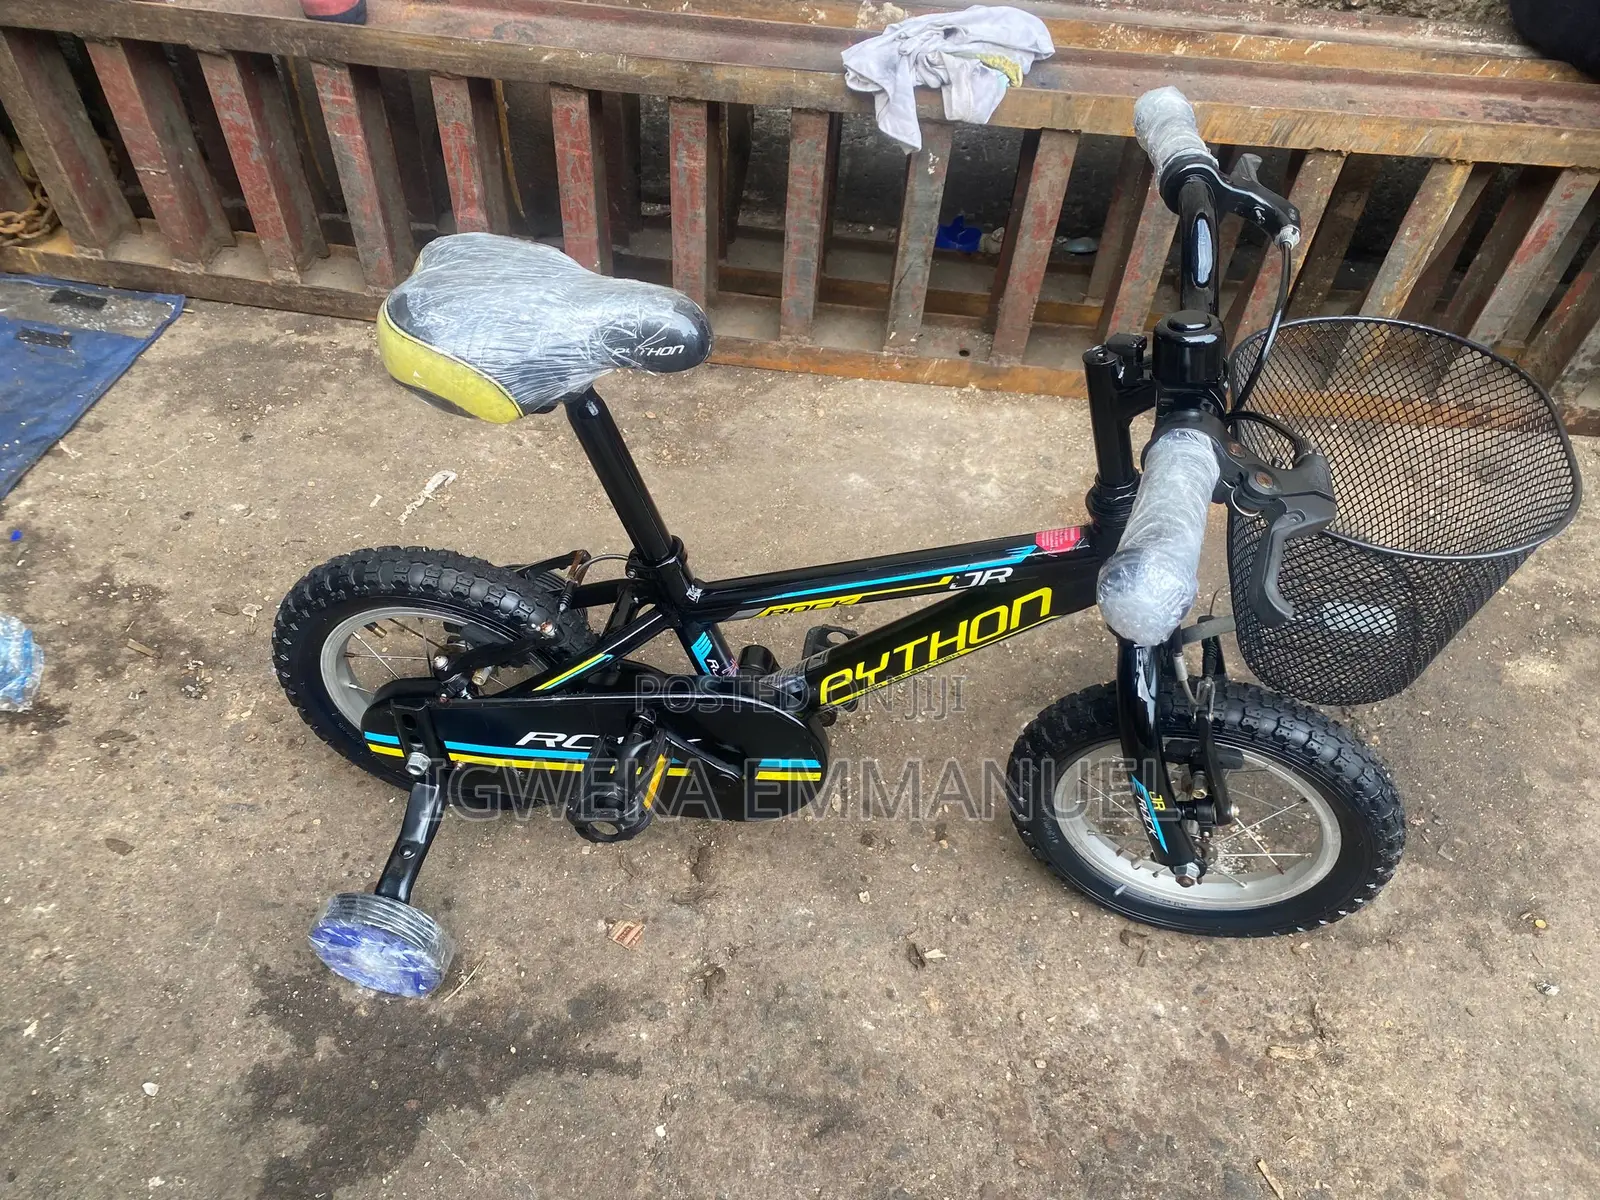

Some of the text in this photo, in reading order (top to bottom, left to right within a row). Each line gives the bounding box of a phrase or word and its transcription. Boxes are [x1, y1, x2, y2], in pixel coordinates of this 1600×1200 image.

[949, 567, 1014, 590] JR
[766, 596, 858, 616] ROCK
[820, 586, 1053, 706] PYTHON
